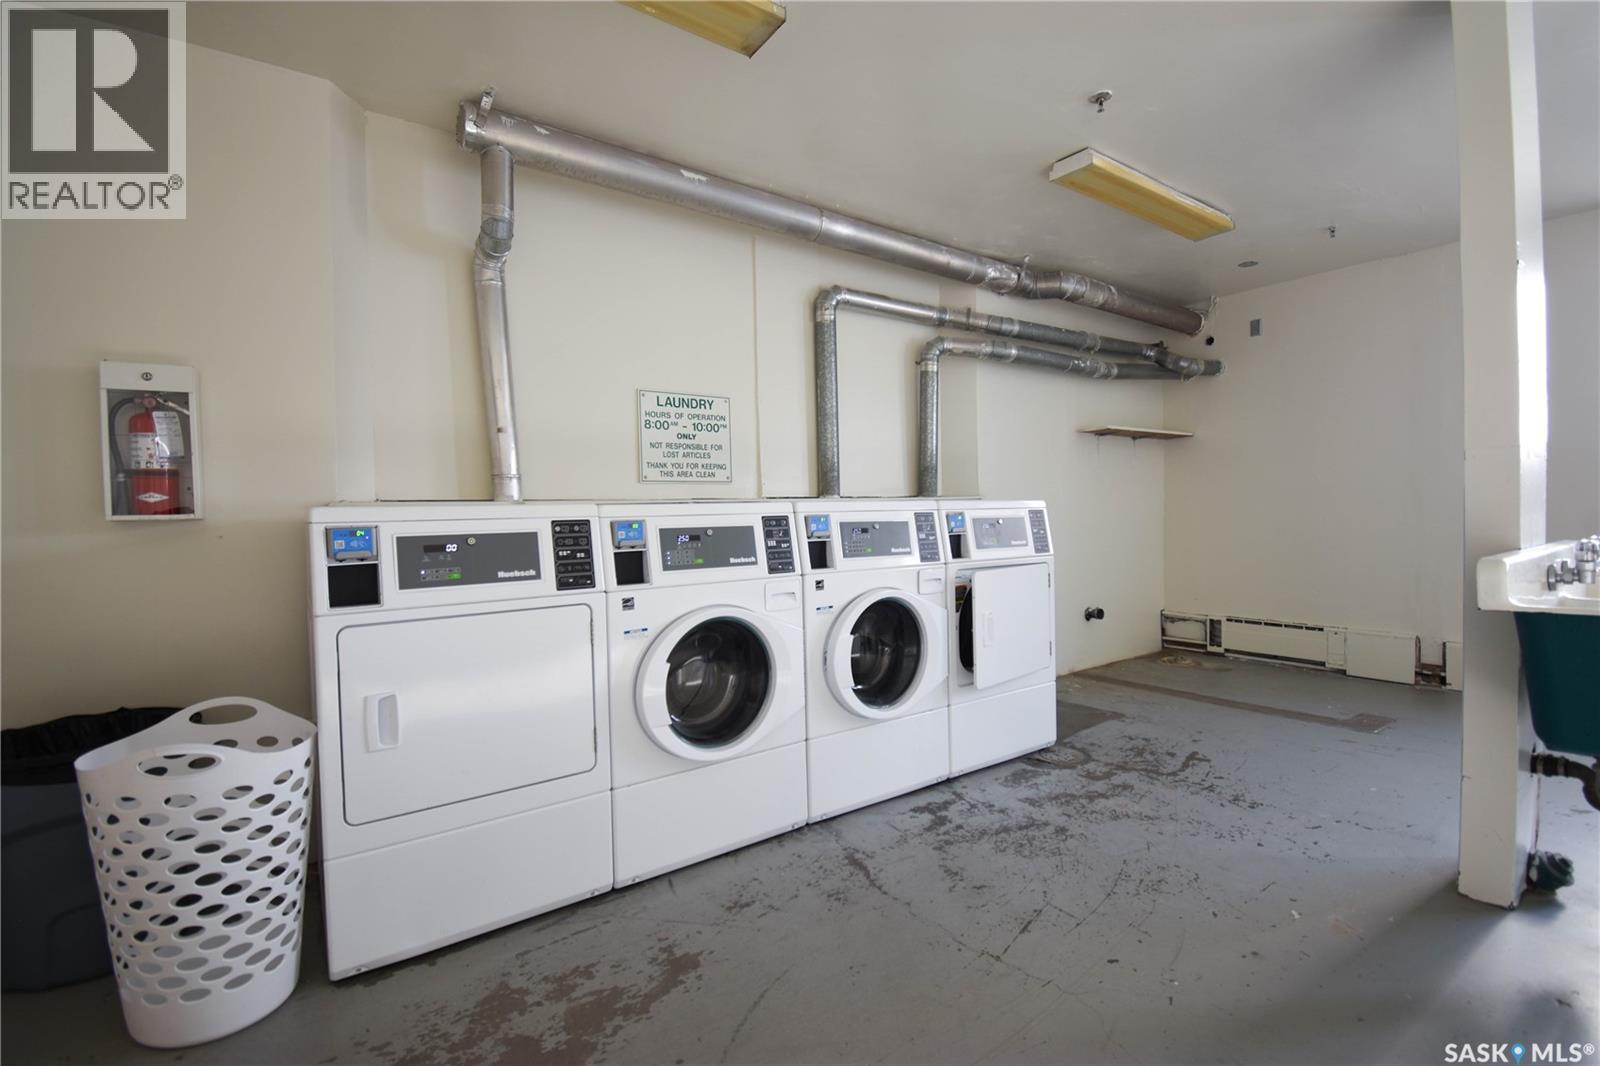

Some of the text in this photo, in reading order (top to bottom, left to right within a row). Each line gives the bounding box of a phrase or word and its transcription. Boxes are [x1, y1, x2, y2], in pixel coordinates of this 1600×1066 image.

[656, 395, 714, 410] LAUNDRY
[644, 410, 726, 422] HOURS OF OPERATION
[676, 432, 697, 441] ONLY
[649, 441, 663, 449] NOT
[665, 442, 708, 451] RESPONSIBLE
[682, 451, 711, 459] ARTICLES
[646, 461, 668, 469] THANK
[670, 462, 684, 470] YOU
[686, 462, 699, 470] FOR
[660, 470, 716, 478] THIS AREA CLEAN
